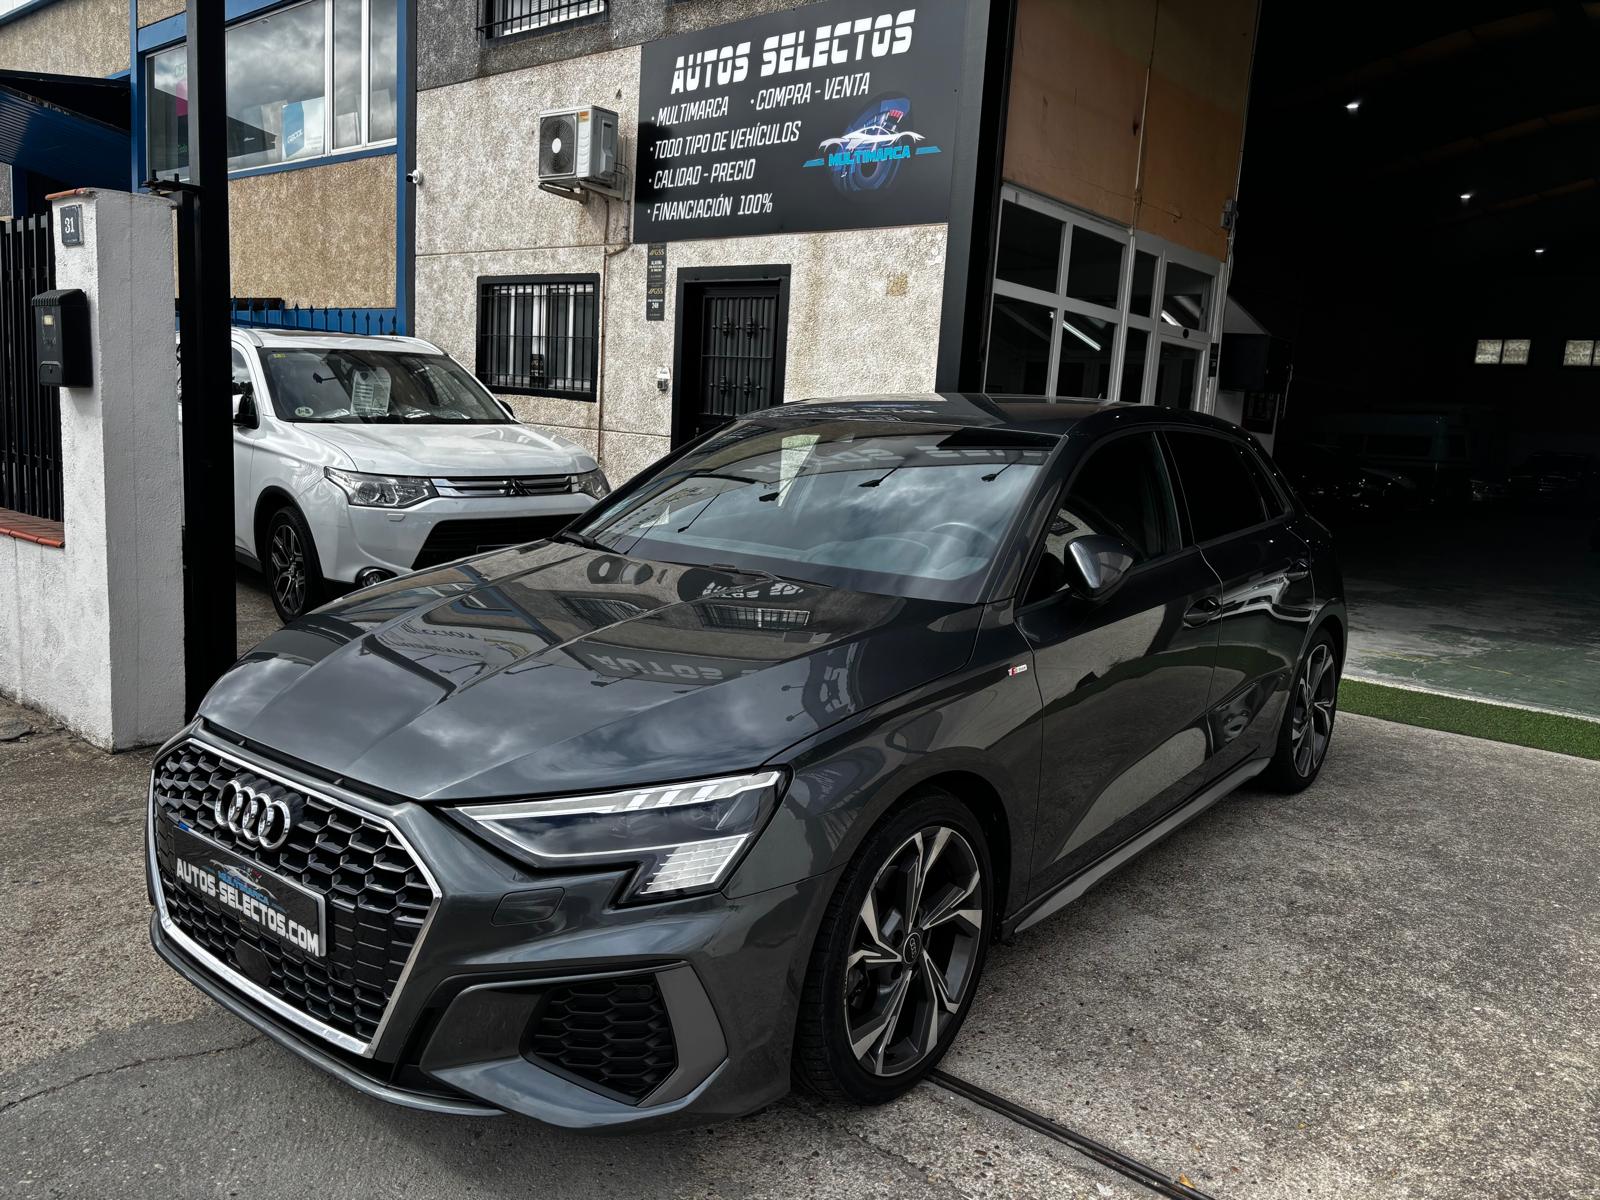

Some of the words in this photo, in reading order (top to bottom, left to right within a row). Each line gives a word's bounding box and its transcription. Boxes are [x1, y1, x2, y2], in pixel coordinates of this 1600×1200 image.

[671, 41, 751, 95] AUTOS
[760, 9, 916, 77] SELECTOS
[756, 81, 811, 111] COMPRA
[824, 72, 870, 101] VENTA
[656, 96, 729, 127] MULTIMARCA
[655, 137, 683, 160] TODO
[685, 133, 710, 155] TIPO
[711, 130, 729, 152] DE
[729, 120, 802, 151] VEHÍCULOS
[828, 145, 911, 167] MULTIMARCA
[653, 165, 702, 189] CALIDAD
[710, 159, 756, 183] PRECIO
[651, 193, 733, 222] FINANCIACIÓN
[737, 193, 773, 215] 100%
[64, 216, 75, 234] 31
